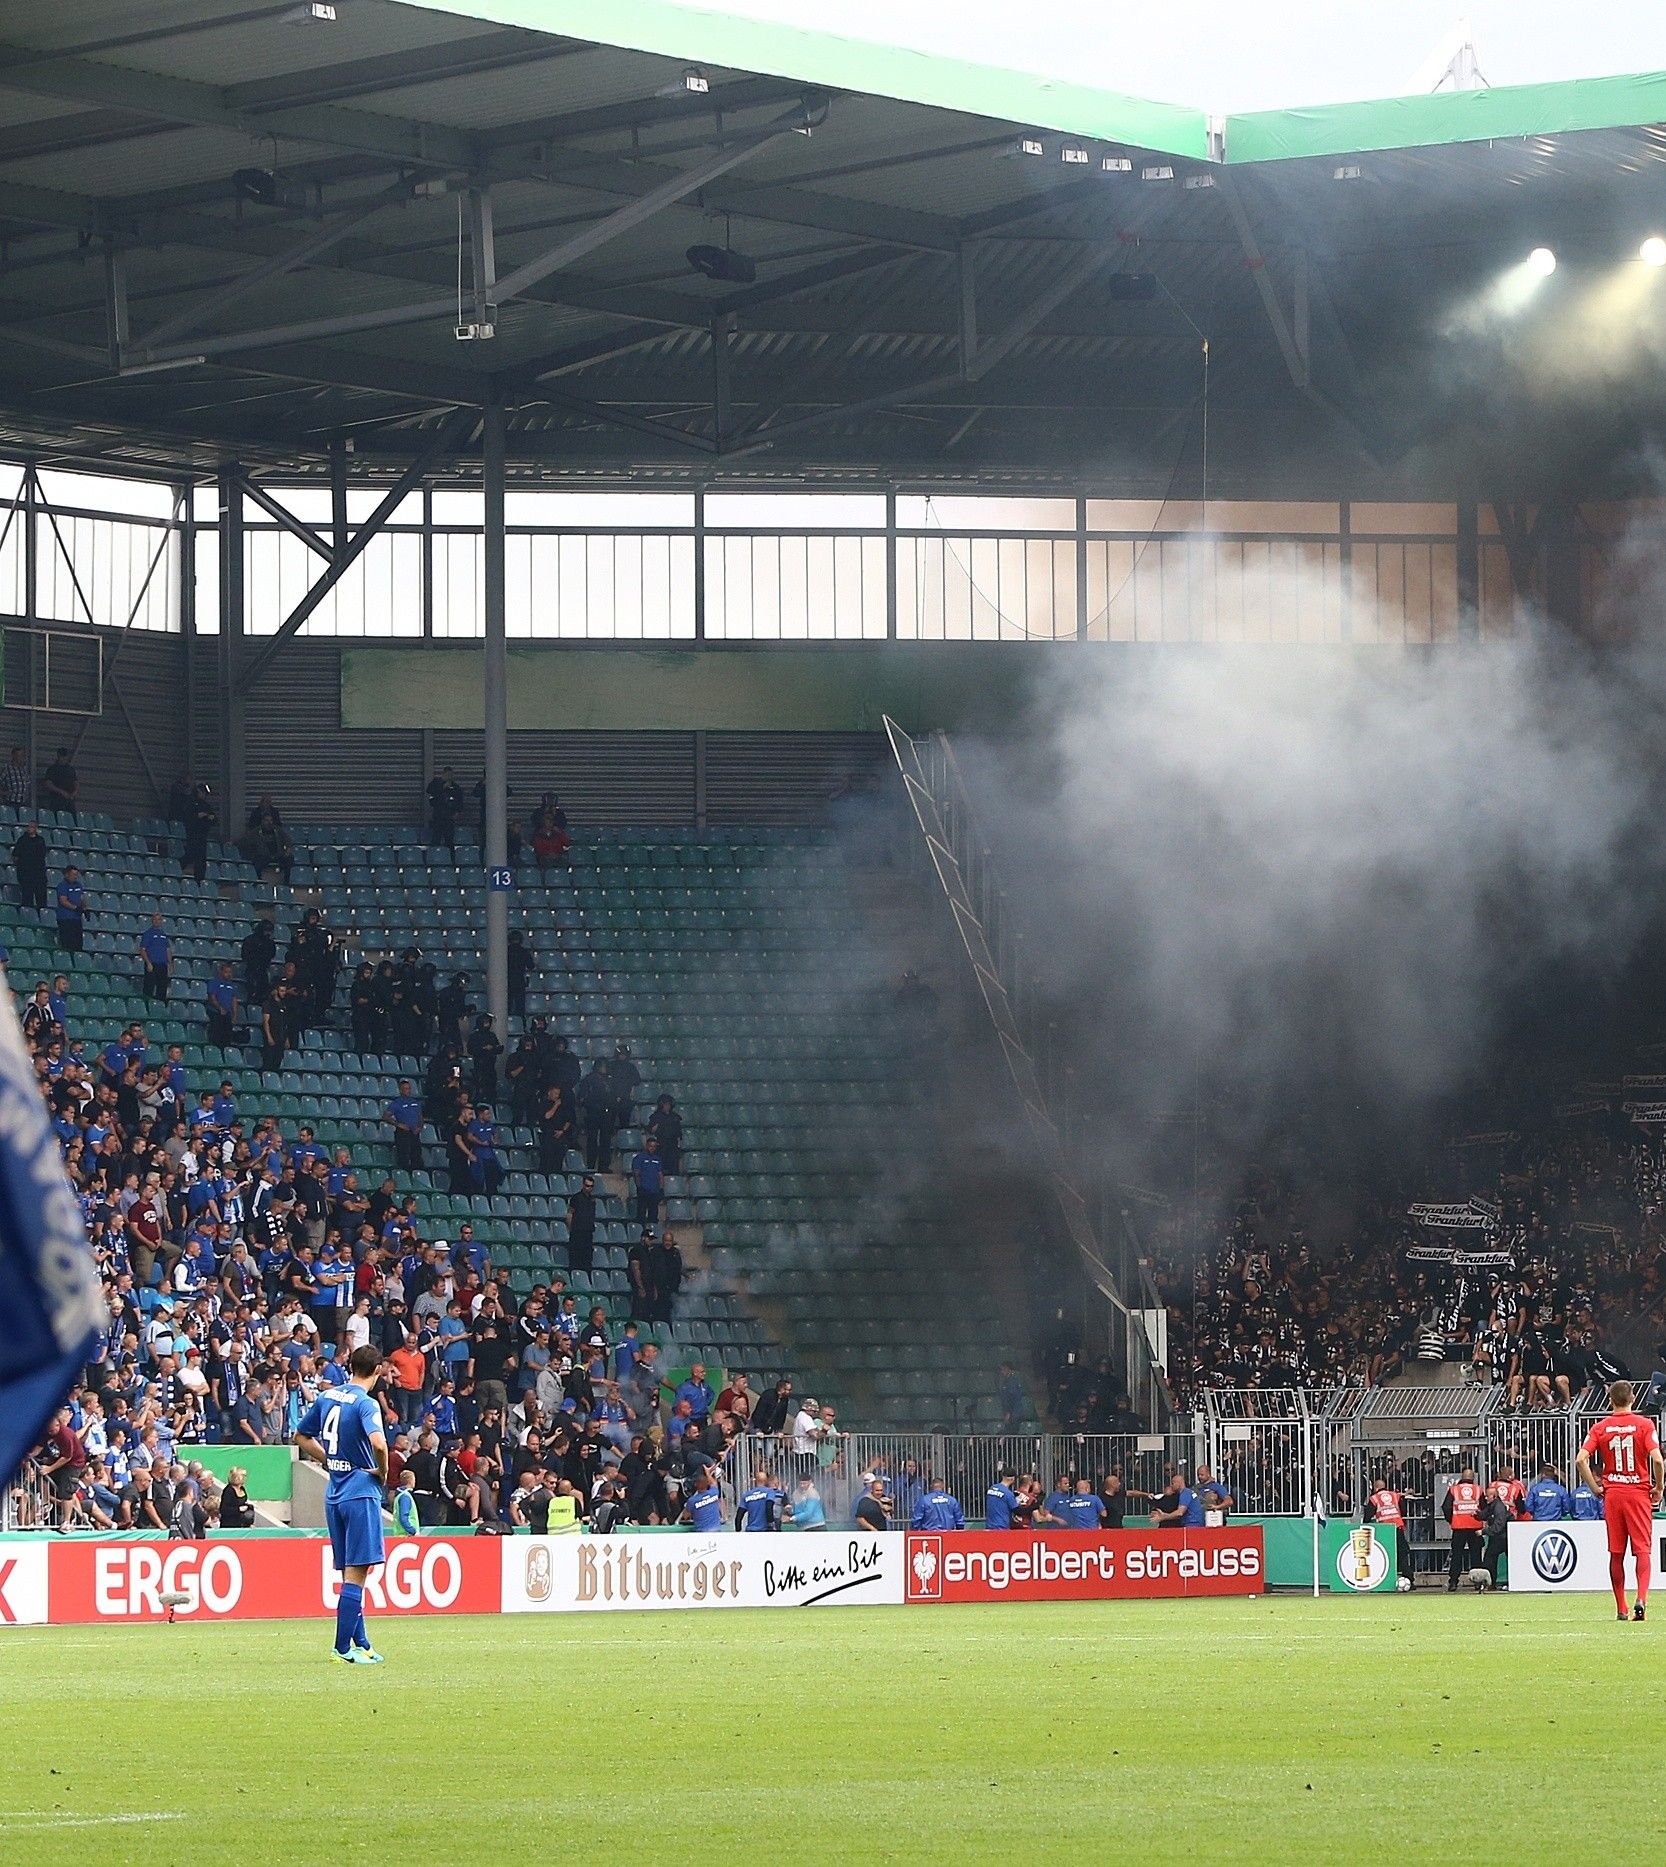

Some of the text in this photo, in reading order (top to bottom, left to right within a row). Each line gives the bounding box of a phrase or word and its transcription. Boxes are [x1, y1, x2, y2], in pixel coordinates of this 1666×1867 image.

[492, 871, 511, 886] 13
[1425, 1214, 1485, 1227] Frankfurt
[322, 1404, 342, 1456] 4
[1609, 1434, 1635, 1472] 11
[94, 1545, 243, 1615] ERGO
[575, 1543, 743, 1601] Bitburger
[763, 1540, 883, 1598] Bitte ein Bit
[944, 1541, 1260, 1589] engelbert strauss
